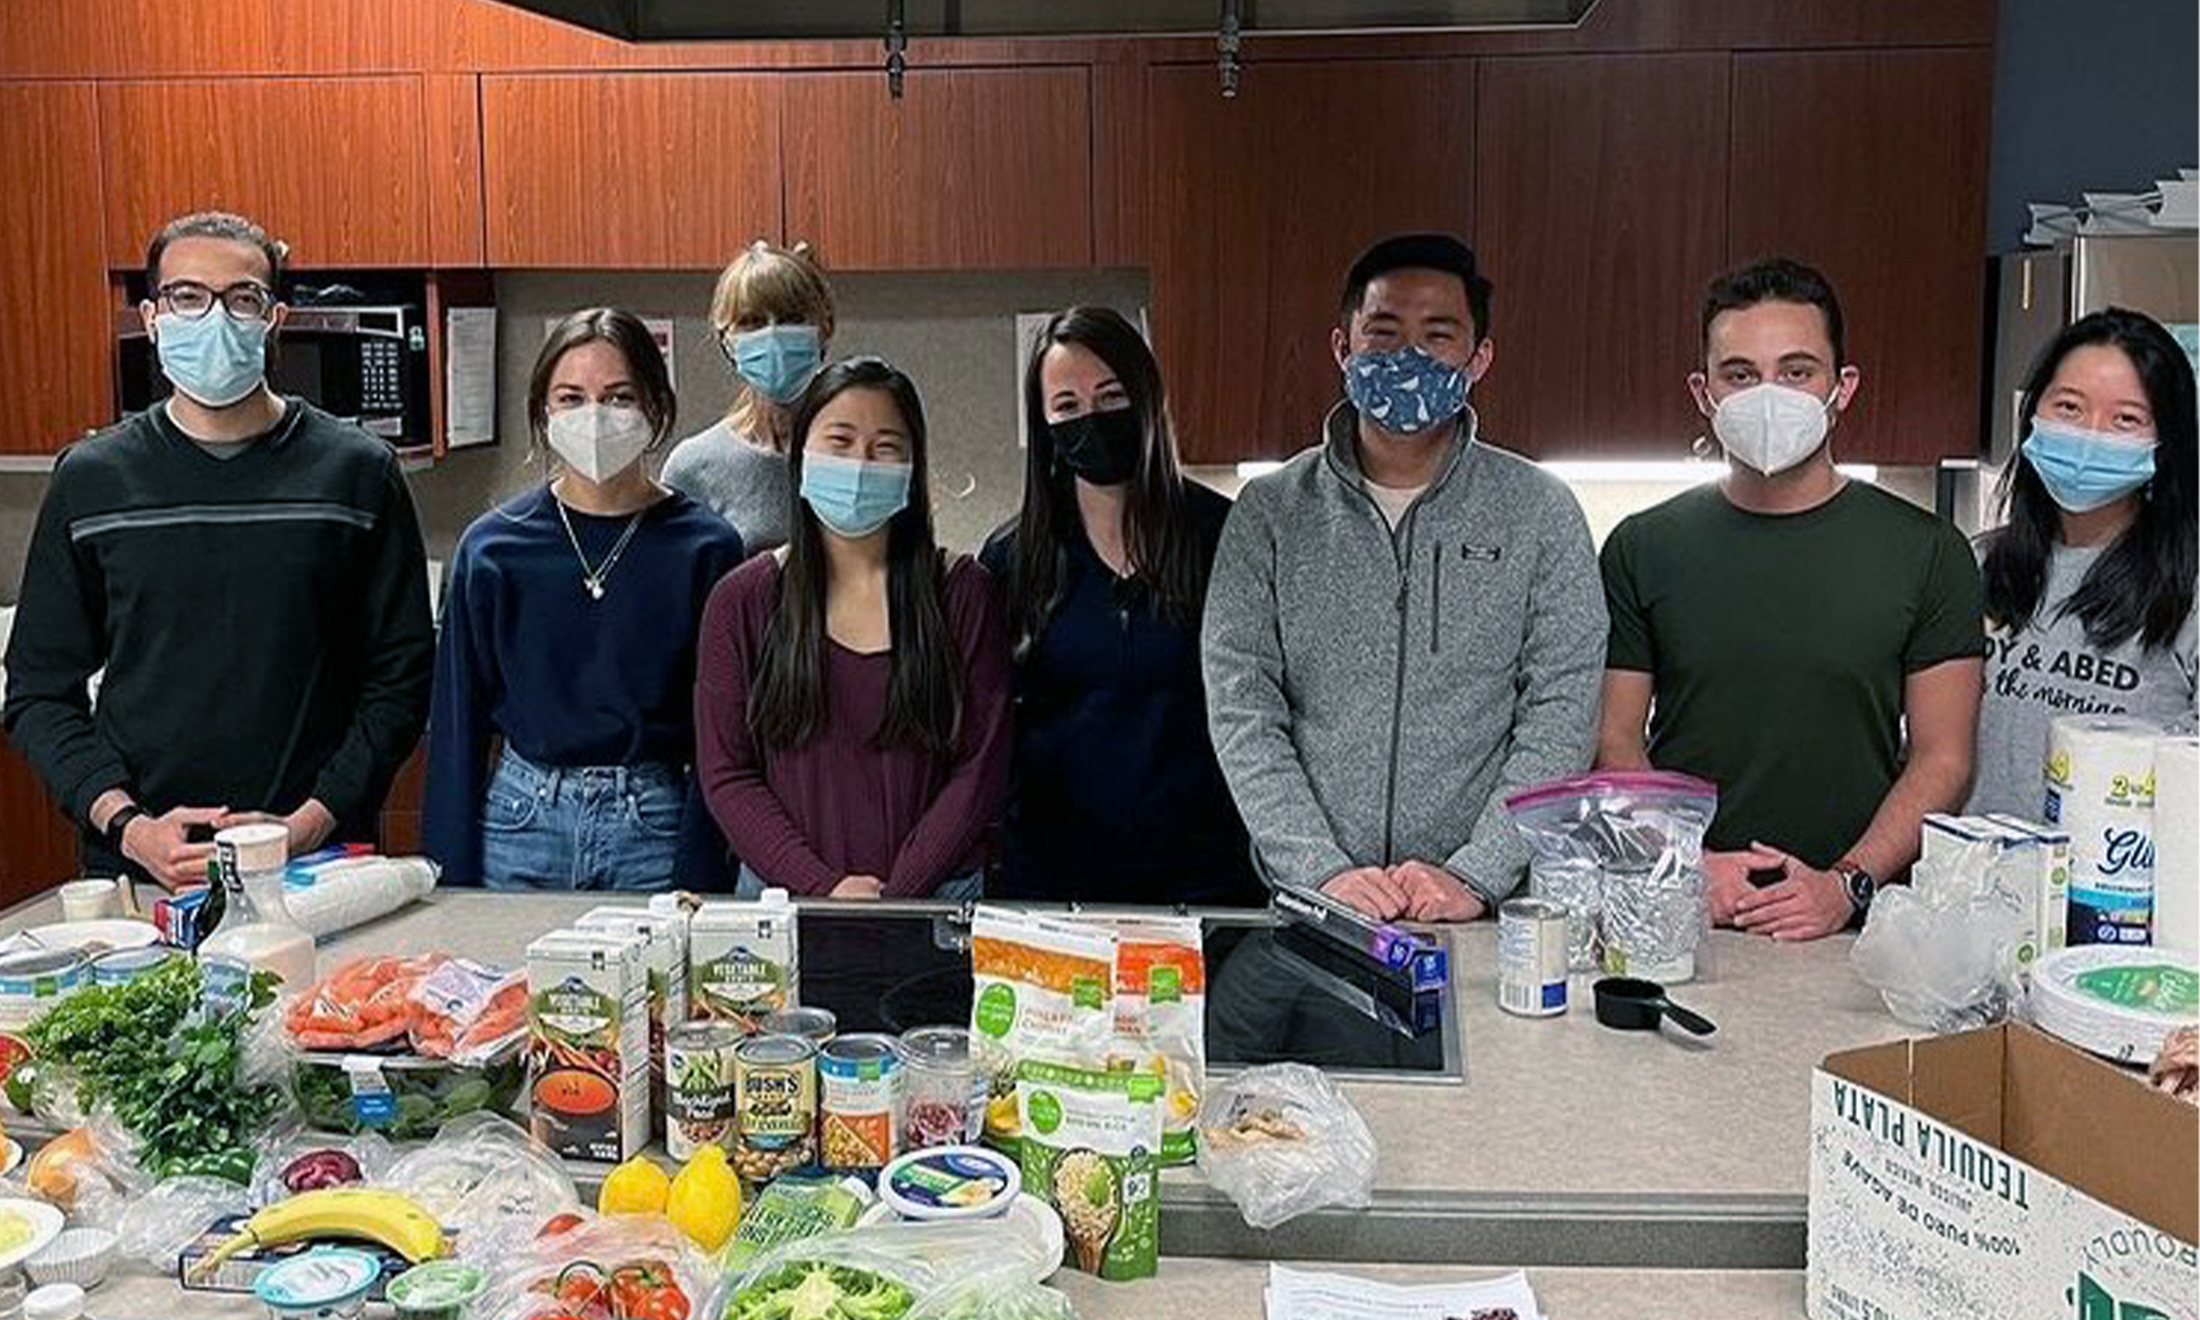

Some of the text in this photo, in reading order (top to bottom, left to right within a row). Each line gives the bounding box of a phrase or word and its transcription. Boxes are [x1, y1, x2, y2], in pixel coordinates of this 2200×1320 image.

[1995, 667, 2028, 698] the
[2022, 644, 2042, 671] &
[2048, 650, 2140, 691] ABED
[2110, 774, 2129, 798] 2
[1834, 1080, 2029, 1211] TEQUILA PLATA
[1842, 1150, 1893, 1202] AGAVE
[1897, 1196, 1919, 1222] DE
[1923, 1213, 1969, 1246] PURO
